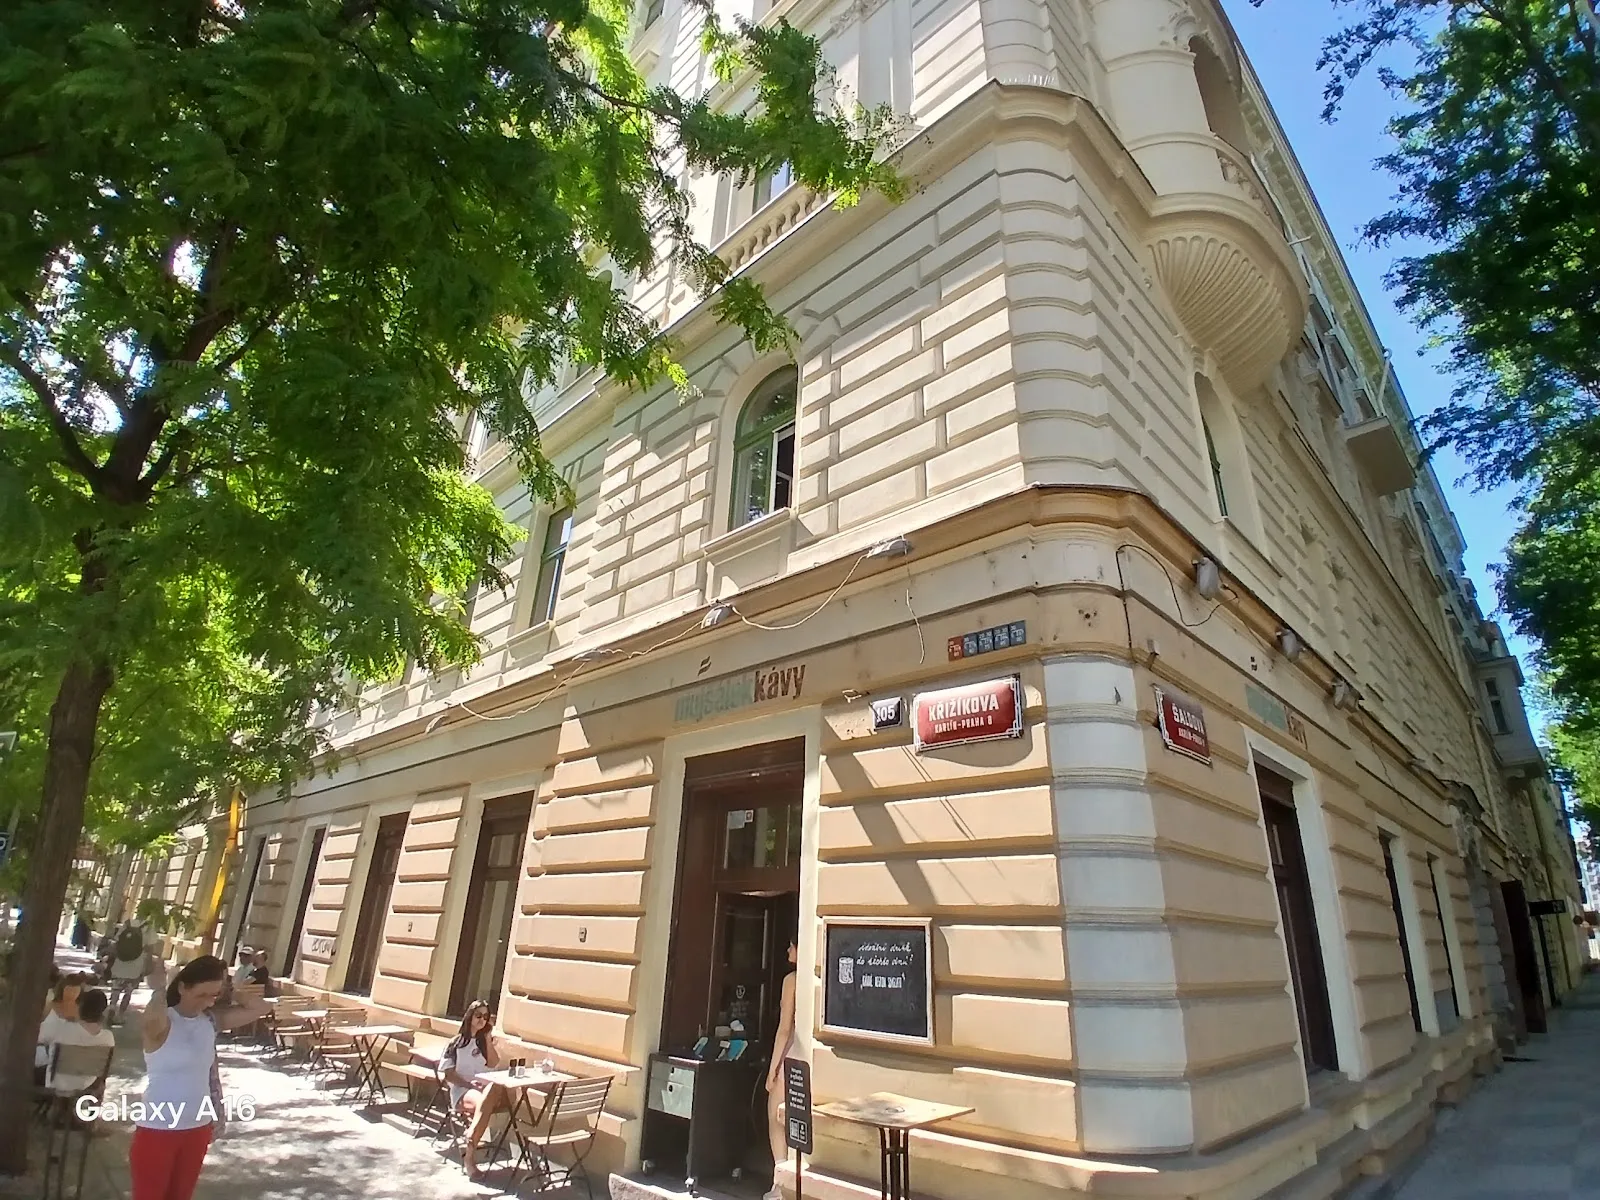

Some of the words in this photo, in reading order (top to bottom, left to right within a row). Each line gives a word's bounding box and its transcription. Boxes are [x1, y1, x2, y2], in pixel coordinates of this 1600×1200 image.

[754, 664, 806, 702] kávy
[876, 705, 896, 723] 105
[928, 694, 1000, 722] KŘIŽÍKOVA
